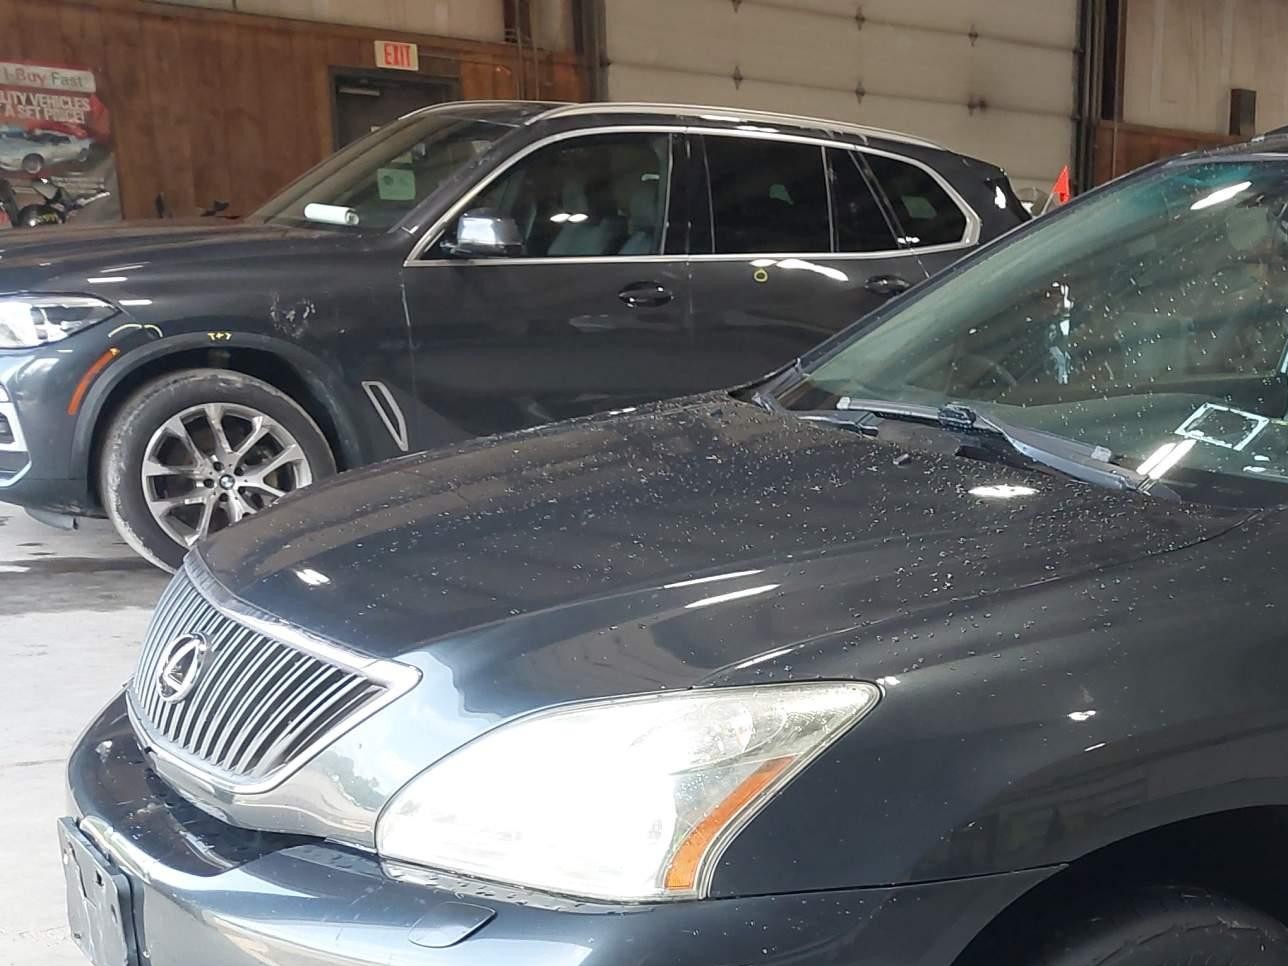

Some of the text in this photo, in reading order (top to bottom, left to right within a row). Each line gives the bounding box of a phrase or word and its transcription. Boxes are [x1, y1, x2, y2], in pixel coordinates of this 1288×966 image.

[384, 43, 411, 67] EXIT
[51, 71, 84, 87] Fast
[28, 92, 90, 111] VEHICLES
[16, 104, 41, 120] SET
[44, 107, 85, 124] PRICE!
